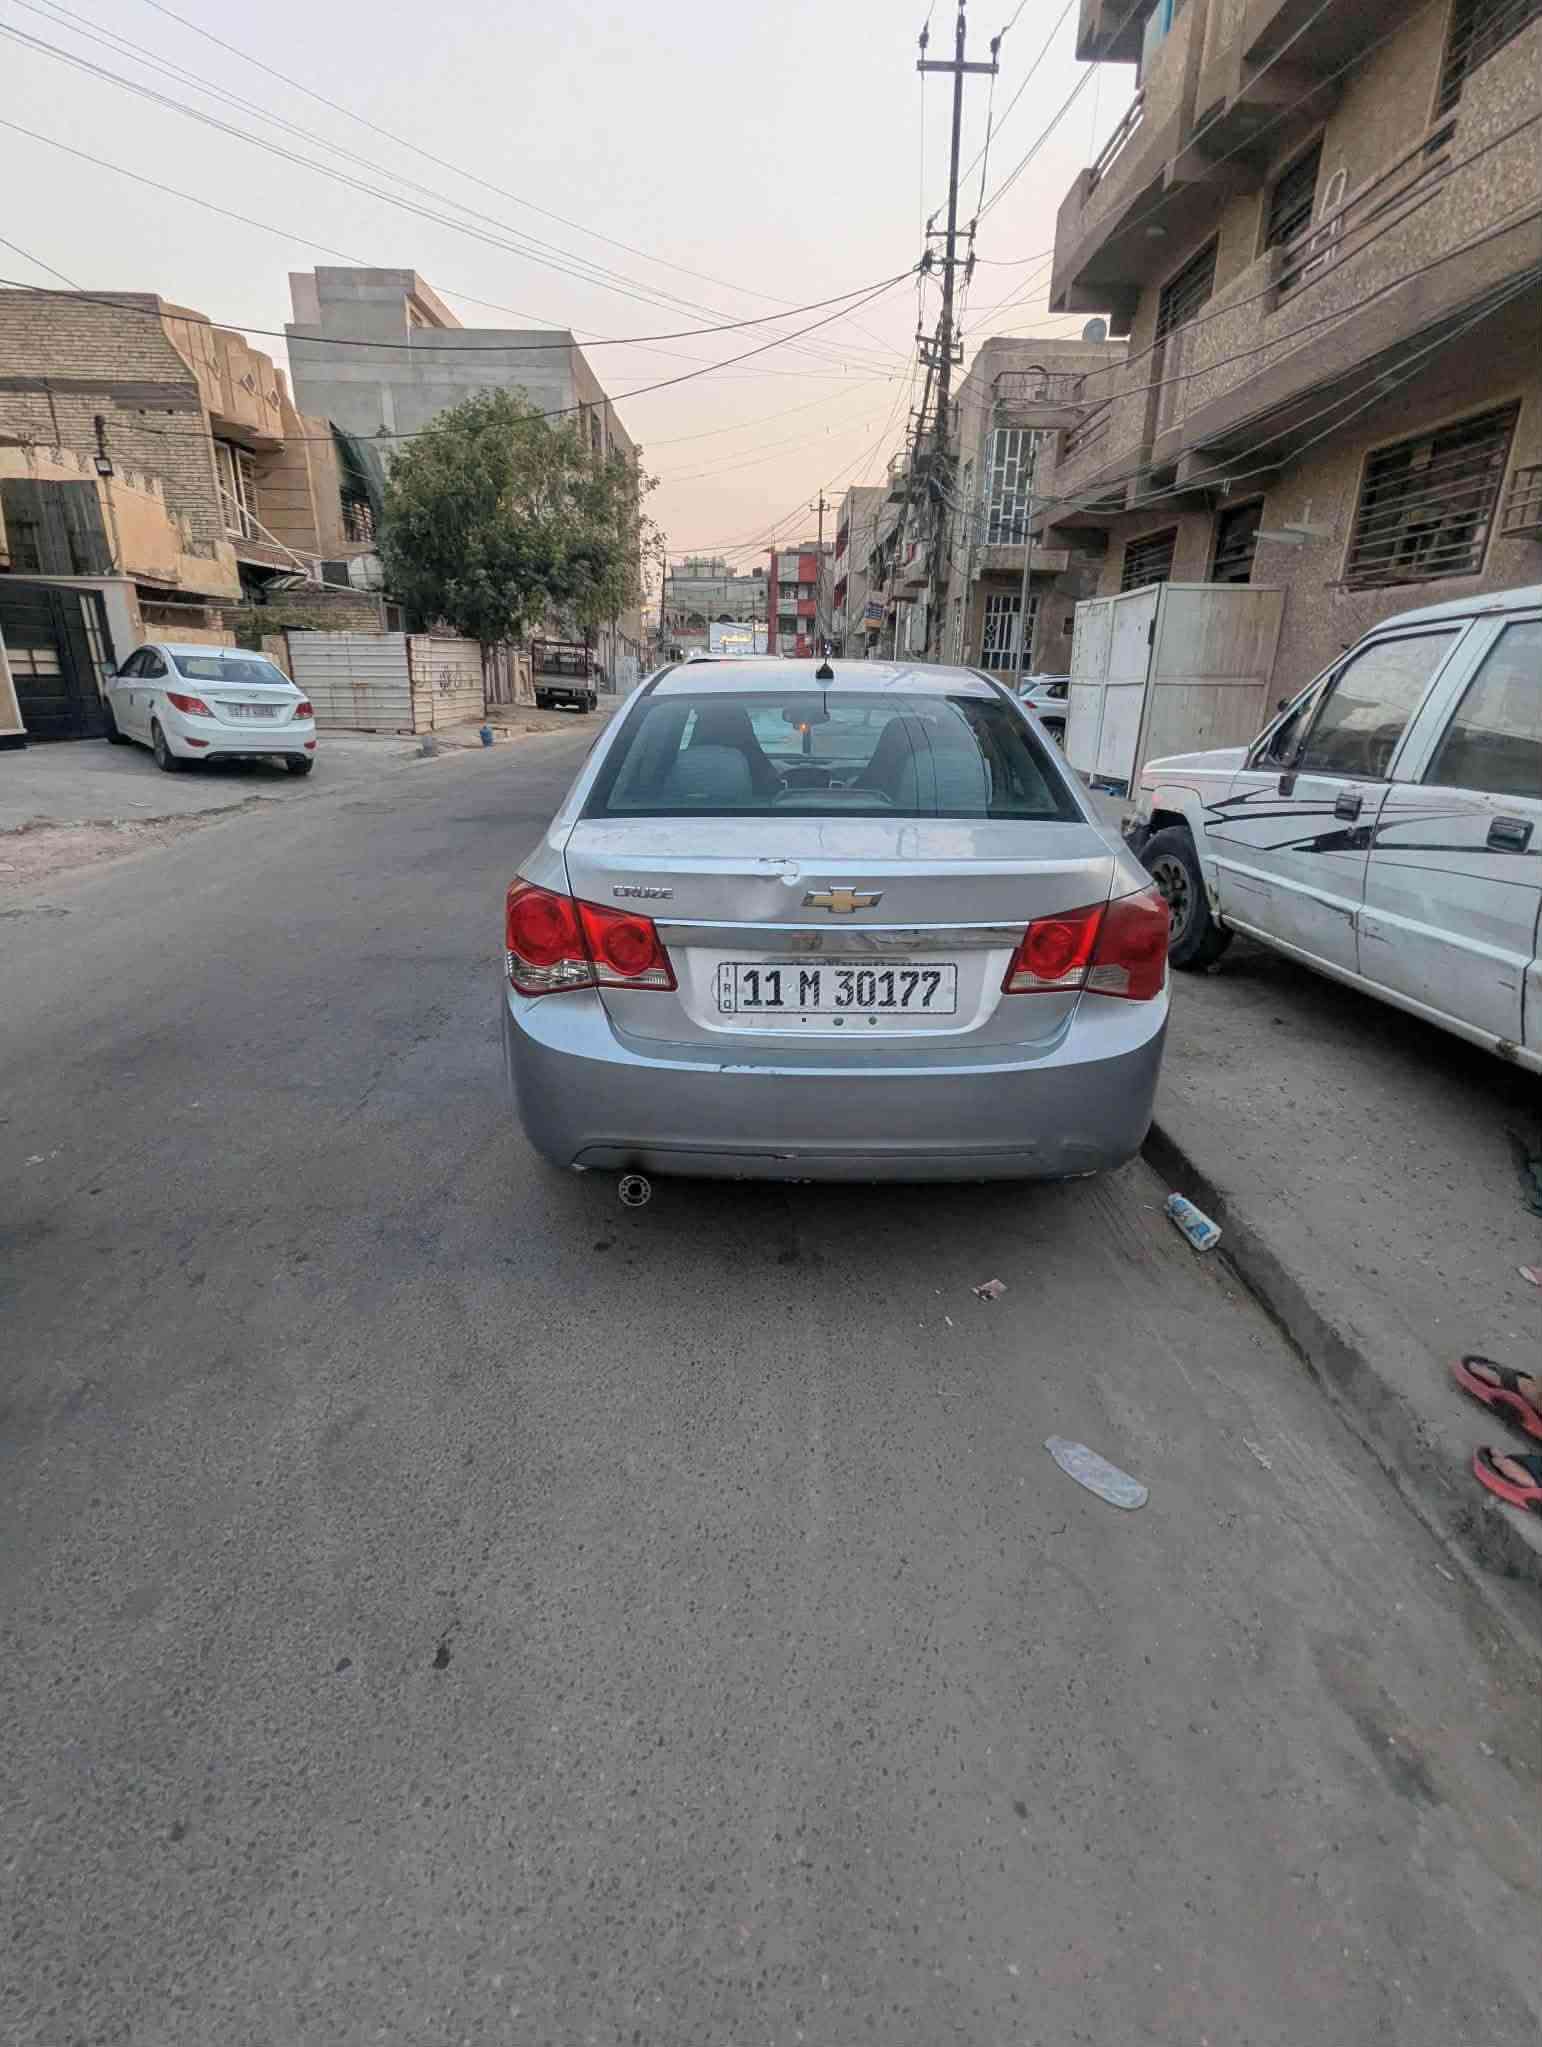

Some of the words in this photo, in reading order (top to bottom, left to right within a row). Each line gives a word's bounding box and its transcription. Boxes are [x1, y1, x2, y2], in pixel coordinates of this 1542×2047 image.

[613, 885, 673, 899] CRUZE
[723, 966, 732, 1009] IRQ
[743, 969, 784, 1007] 11
[799, 969, 821, 1007] M
[834, 969, 942, 1007] 30177
